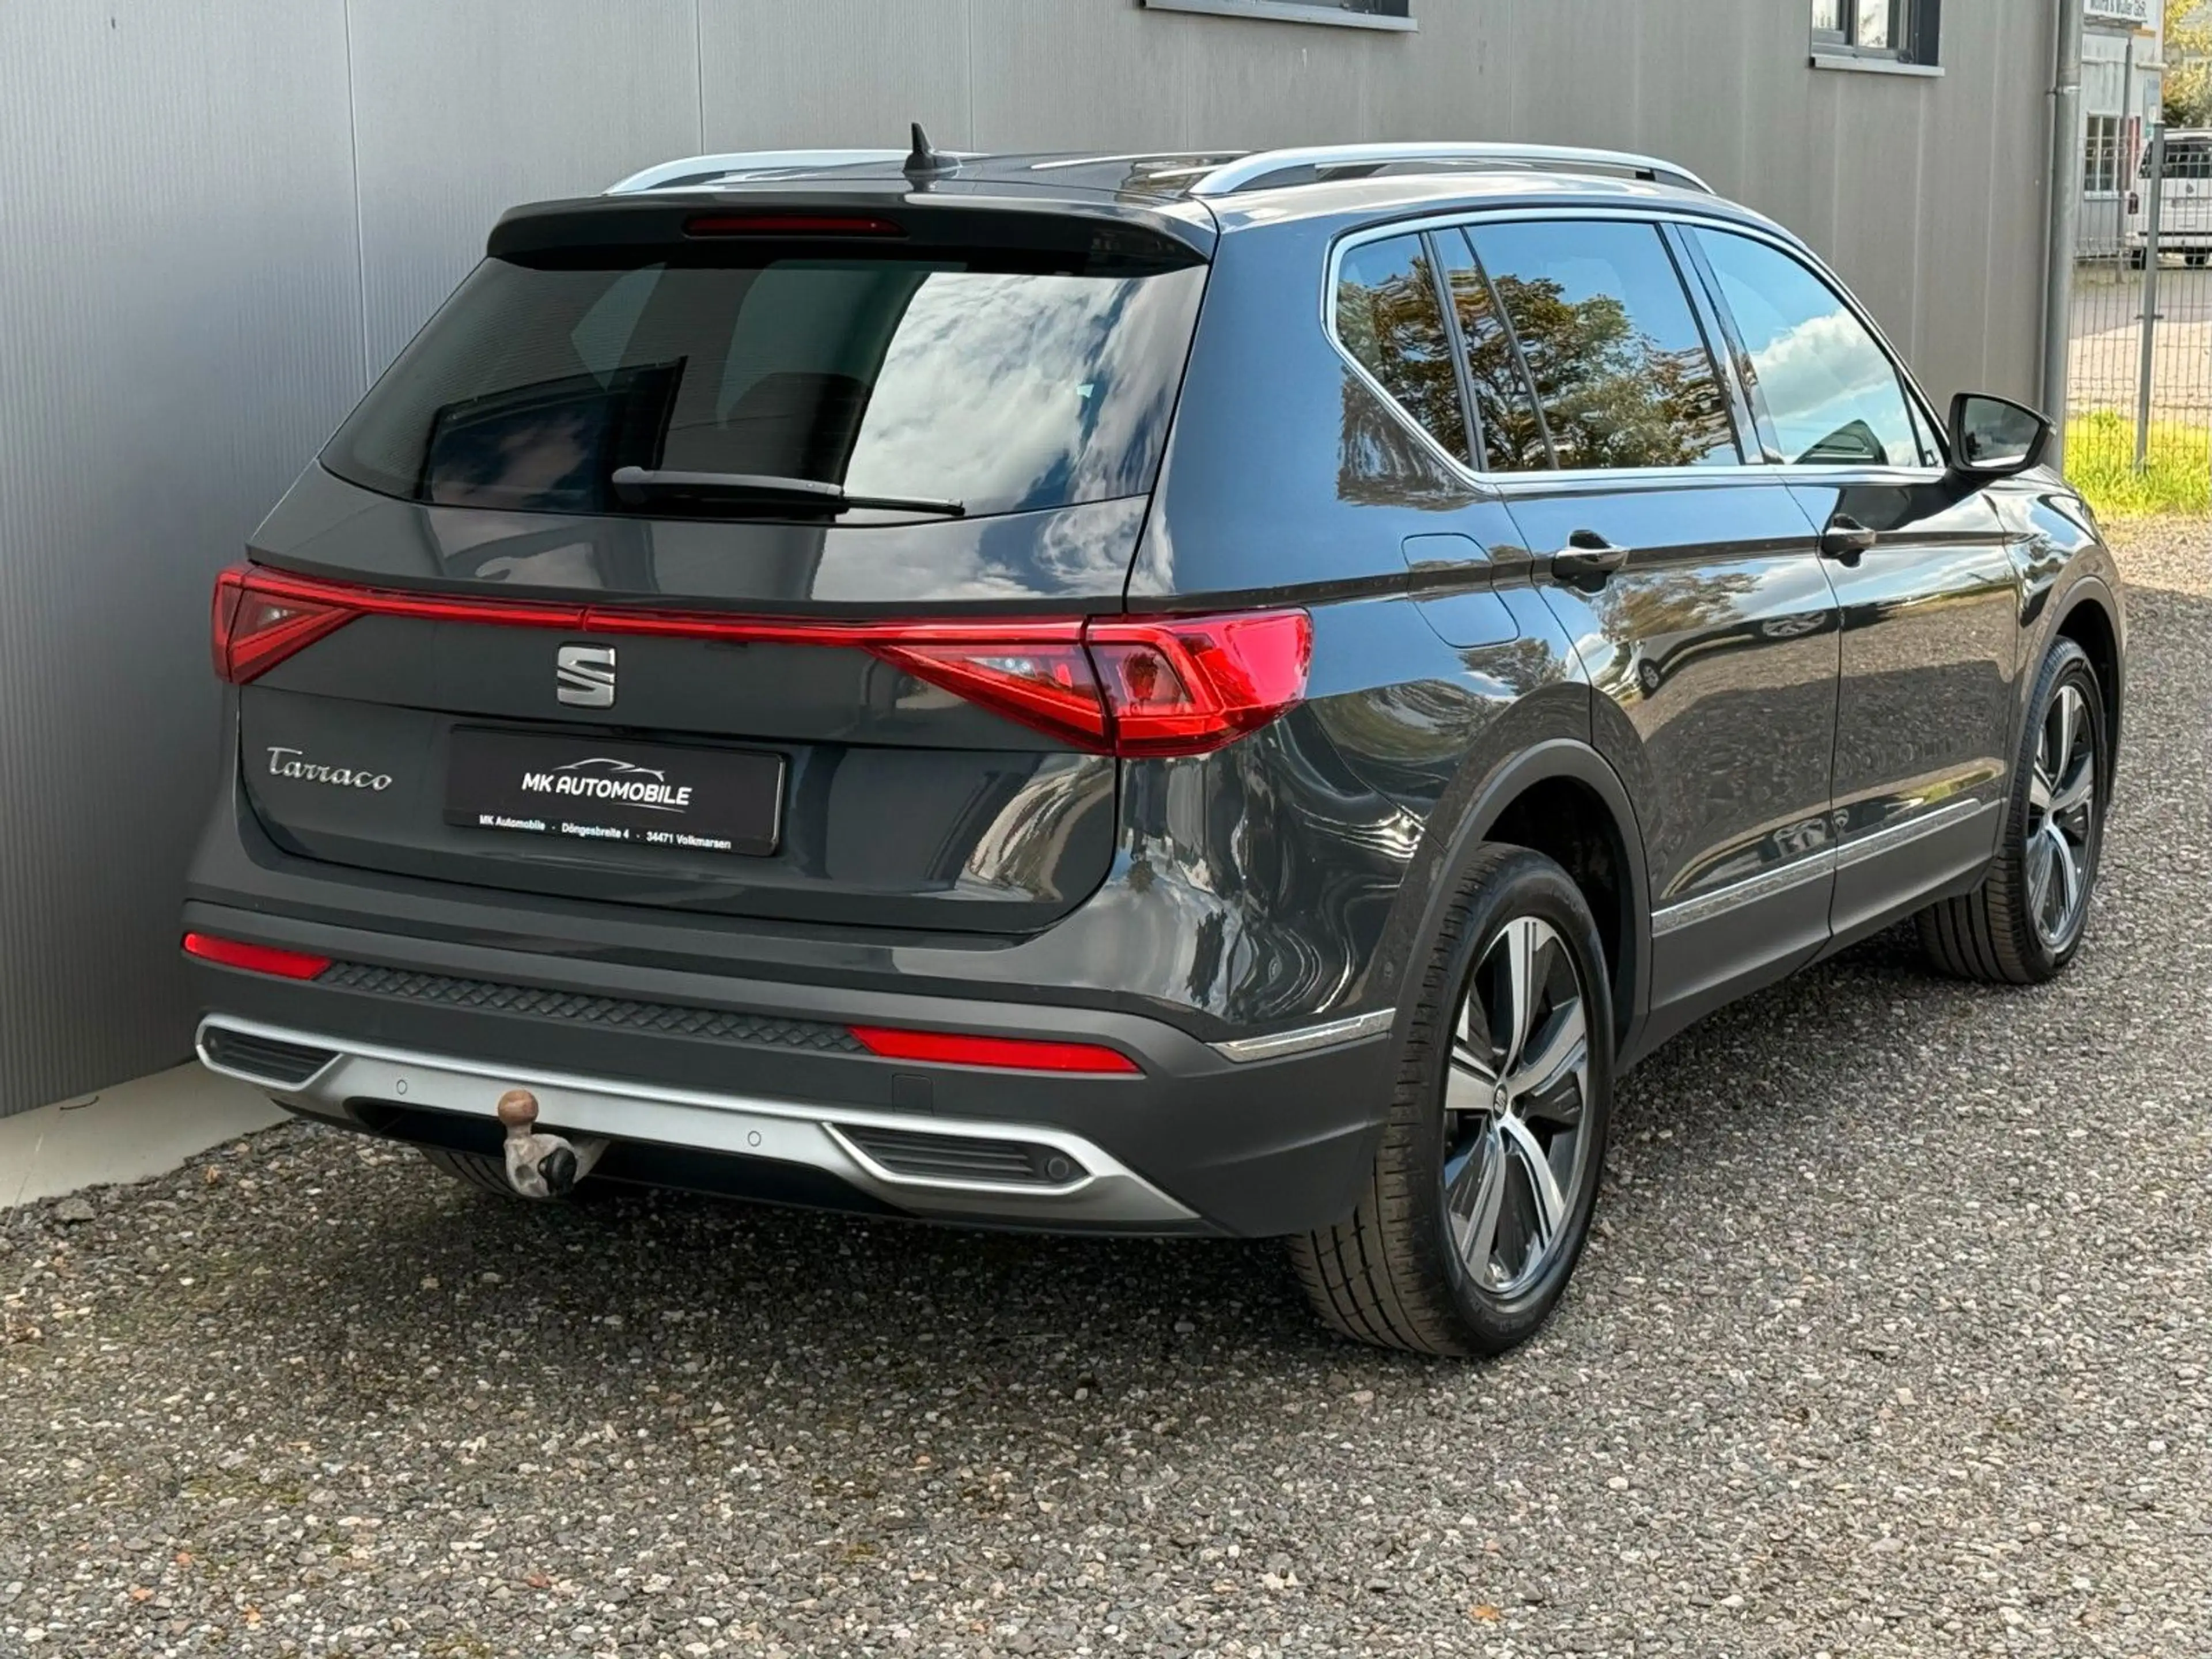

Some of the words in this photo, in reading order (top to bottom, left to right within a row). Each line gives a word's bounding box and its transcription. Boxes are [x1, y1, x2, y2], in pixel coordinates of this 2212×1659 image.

[266, 747, 393, 791] Tarraco
[521, 772, 554, 792] MK
[555, 775, 693, 805] AUTOMOBILE
[479, 815, 494, 825] MK
[495, 816, 546, 831] Automobile
[623, 828, 629, 839] 4
[646, 831, 673, 843] 34471
[676, 834, 732, 849] Volkmarsen
